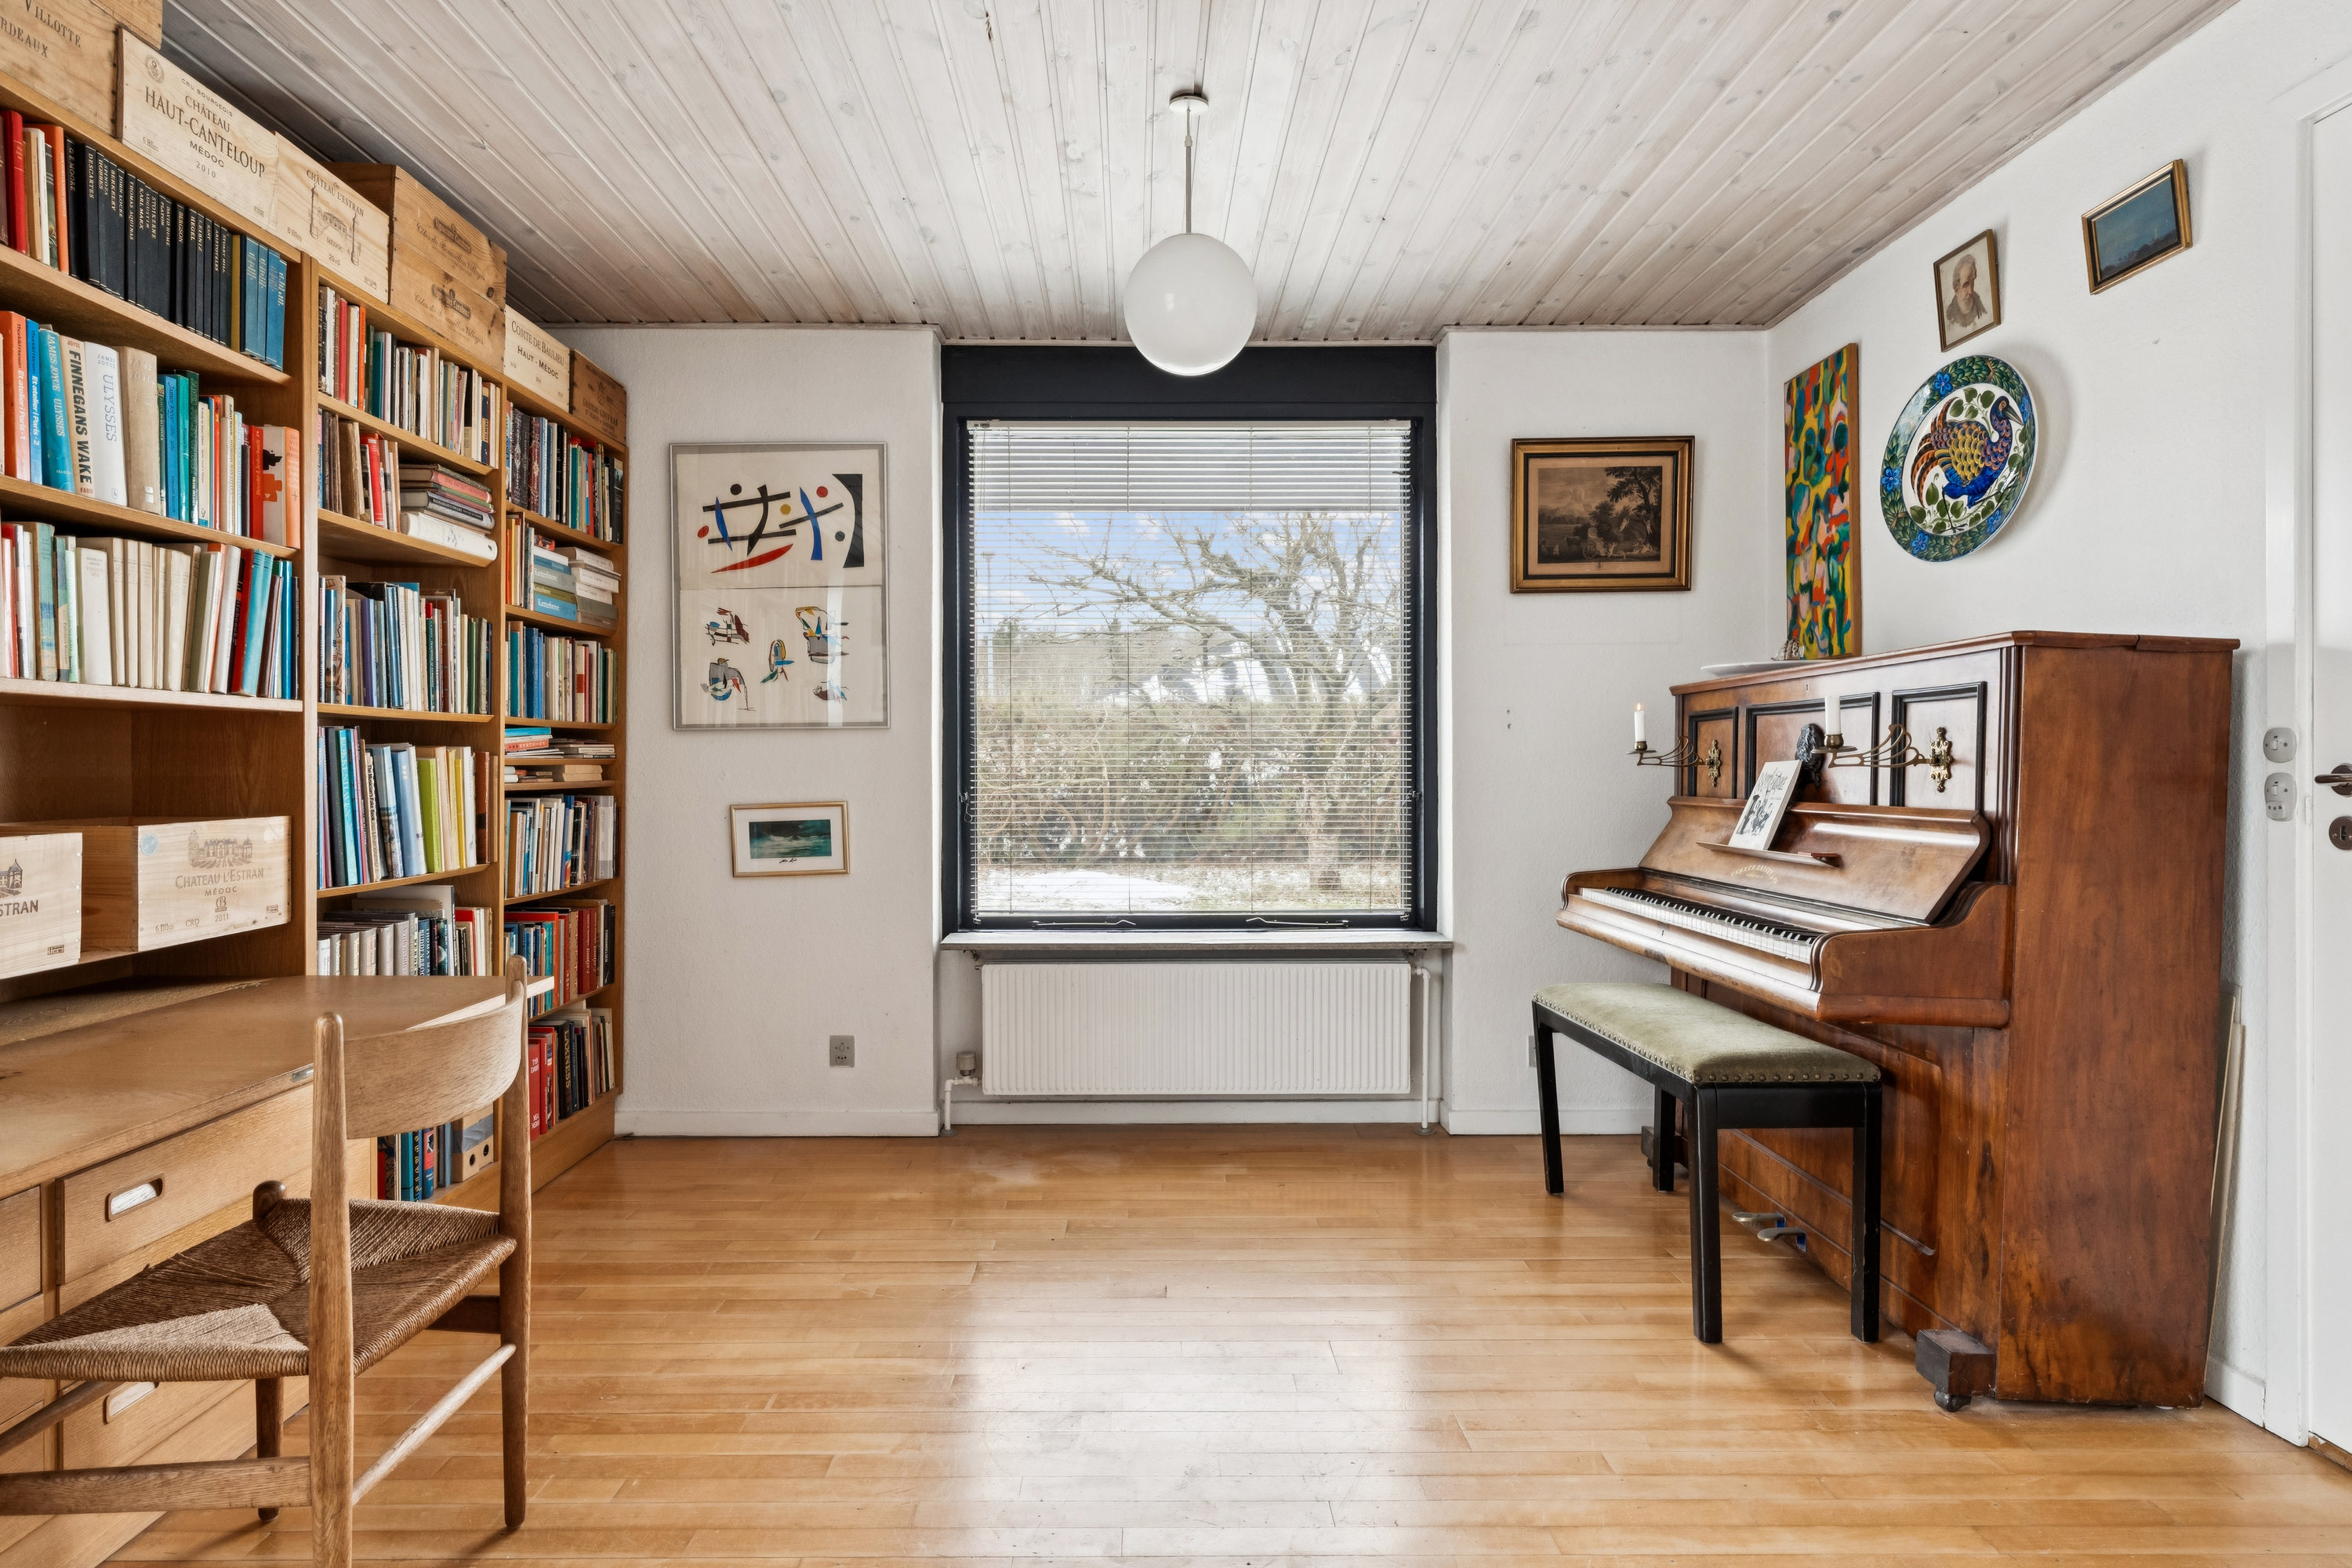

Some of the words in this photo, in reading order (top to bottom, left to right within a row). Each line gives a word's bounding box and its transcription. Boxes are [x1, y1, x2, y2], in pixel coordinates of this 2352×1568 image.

[181, 78, 194, 90] CRU
[197, 89, 233, 117] BOURGEOIS
[185, 95, 230, 132] CHÂTEAU
[146, 86, 265, 178] HAUT-CANTELOUP
[190, 140, 224, 168] MÉDOC
[196, 161, 216, 178] 2010
[337, 192, 365, 217] L'ESTRAN
[47, 335, 58, 365] JAMES
[511, 321, 532, 344] COMTE
[533, 337, 541, 350] DE
[517, 346, 534, 364] HAUT
[539, 359, 559, 379] MÉDOC
[51, 365, 60, 392] JOYCE
[69, 350, 88, 437] FINNEGANS
[53, 397, 65, 437] ULYSSES
[102, 374, 117, 442] ULYSSES
[77, 440, 93, 485] WAKE
[176, 873, 220, 890] CHATEAU
[223, 868, 264, 884] L'ESTRAN
[204, 885, 238, 897] MÉDOC
[215, 913, 229, 922] 2011
